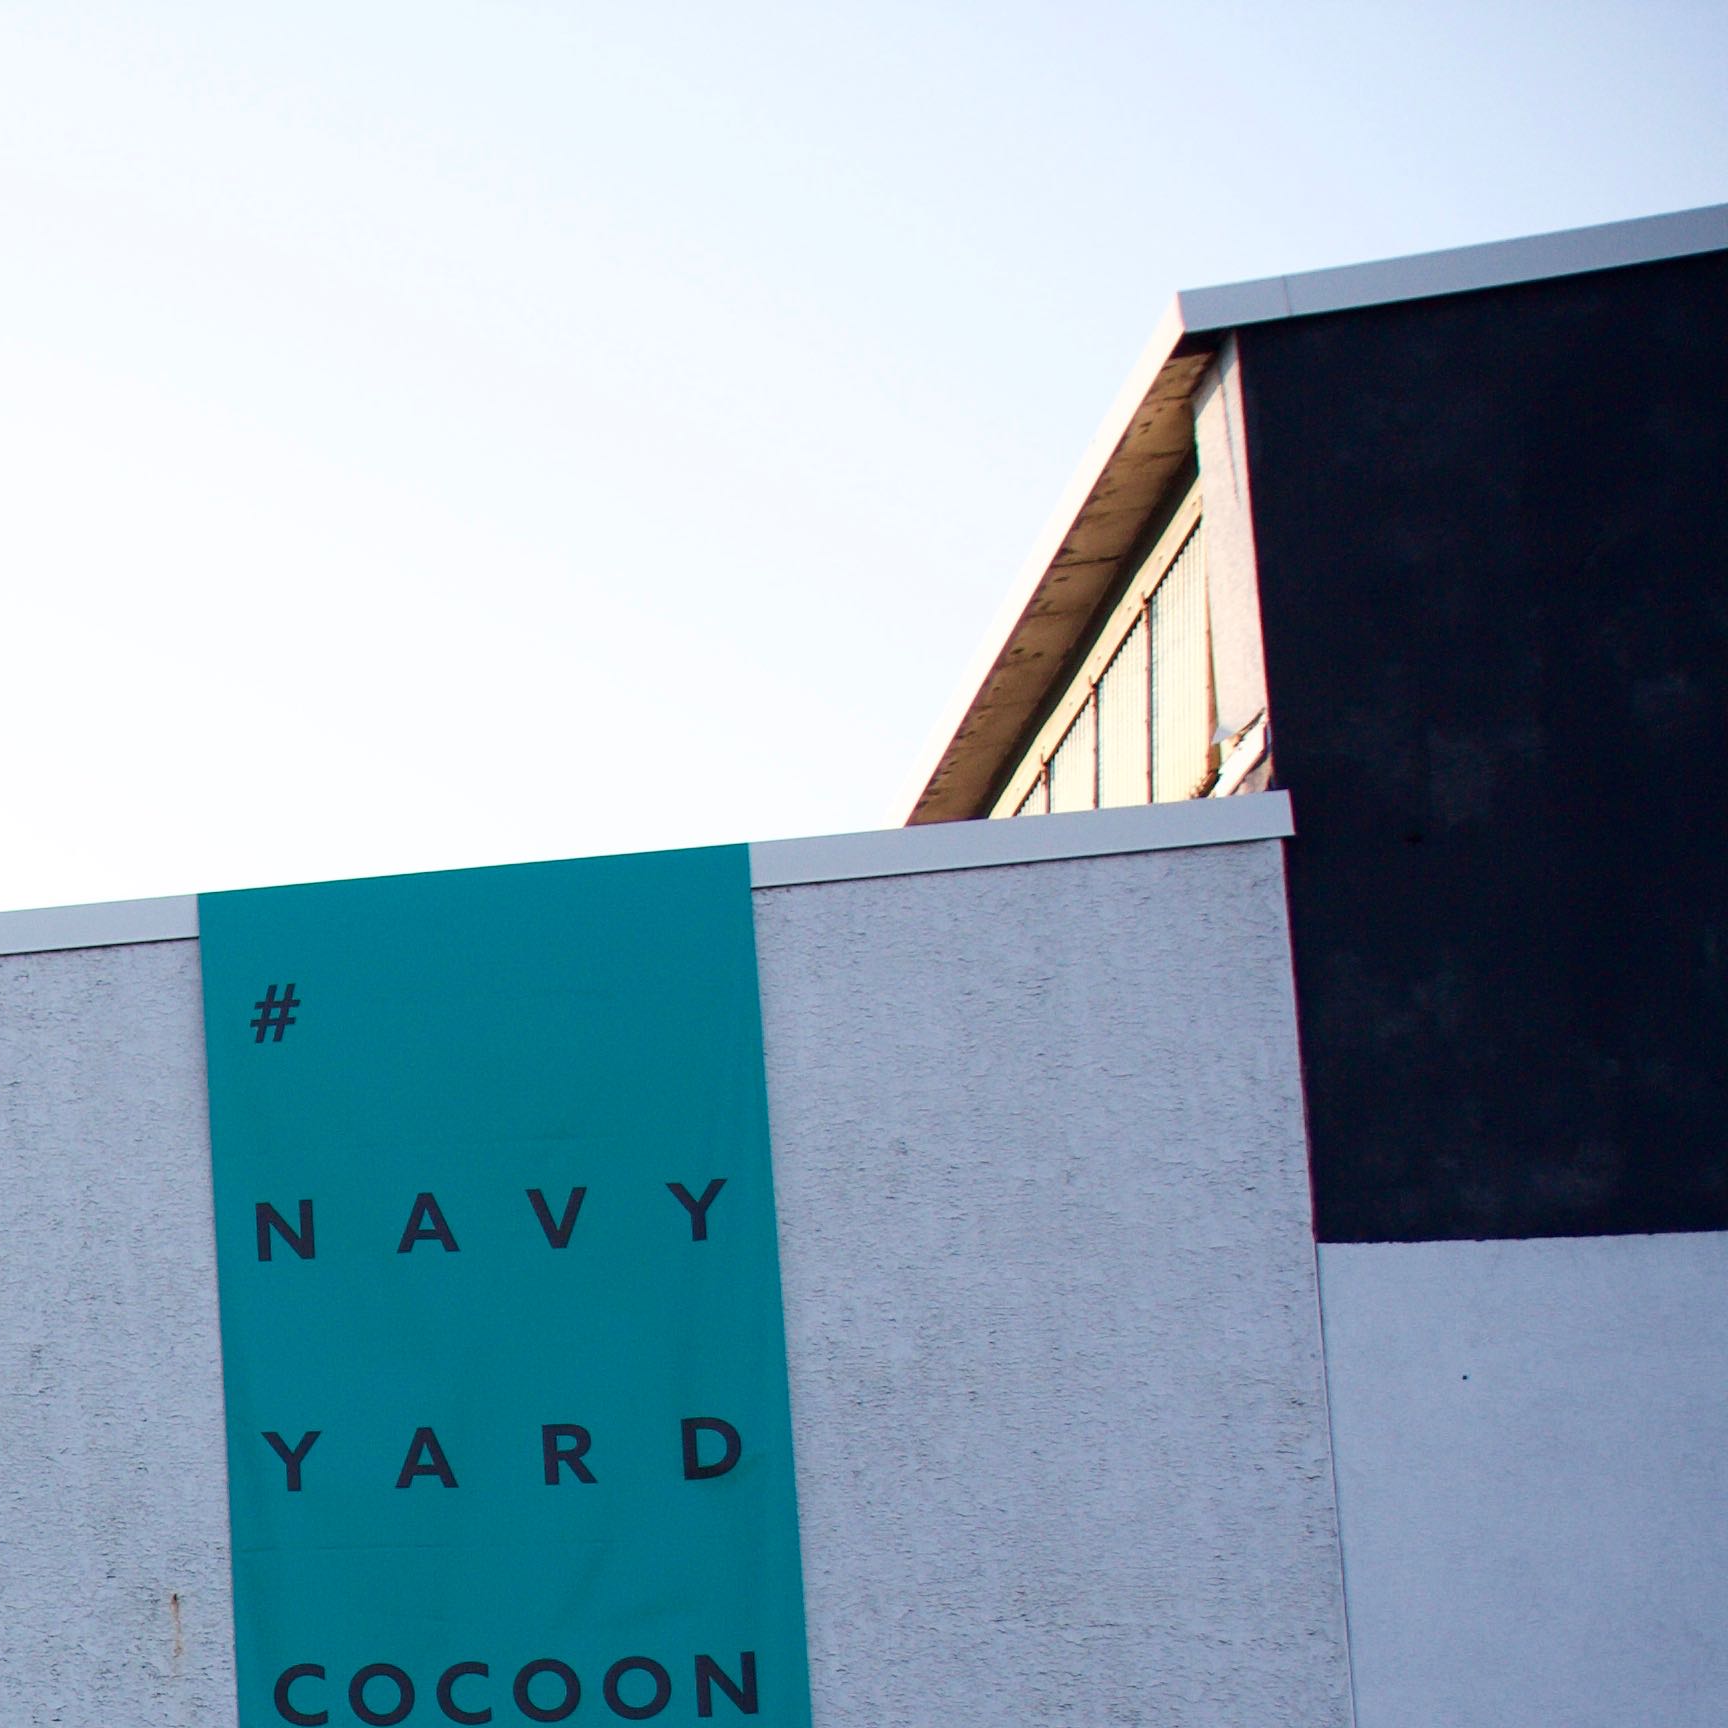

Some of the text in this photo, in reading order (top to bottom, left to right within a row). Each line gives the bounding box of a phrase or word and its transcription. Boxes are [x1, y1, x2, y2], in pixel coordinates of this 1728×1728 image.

[249, 982, 302, 1044] #
[255, 1178, 728, 1262] NAVY
[260, 1416, 743, 1492] YARD
[273, 1650, 760, 1728] COCOON
